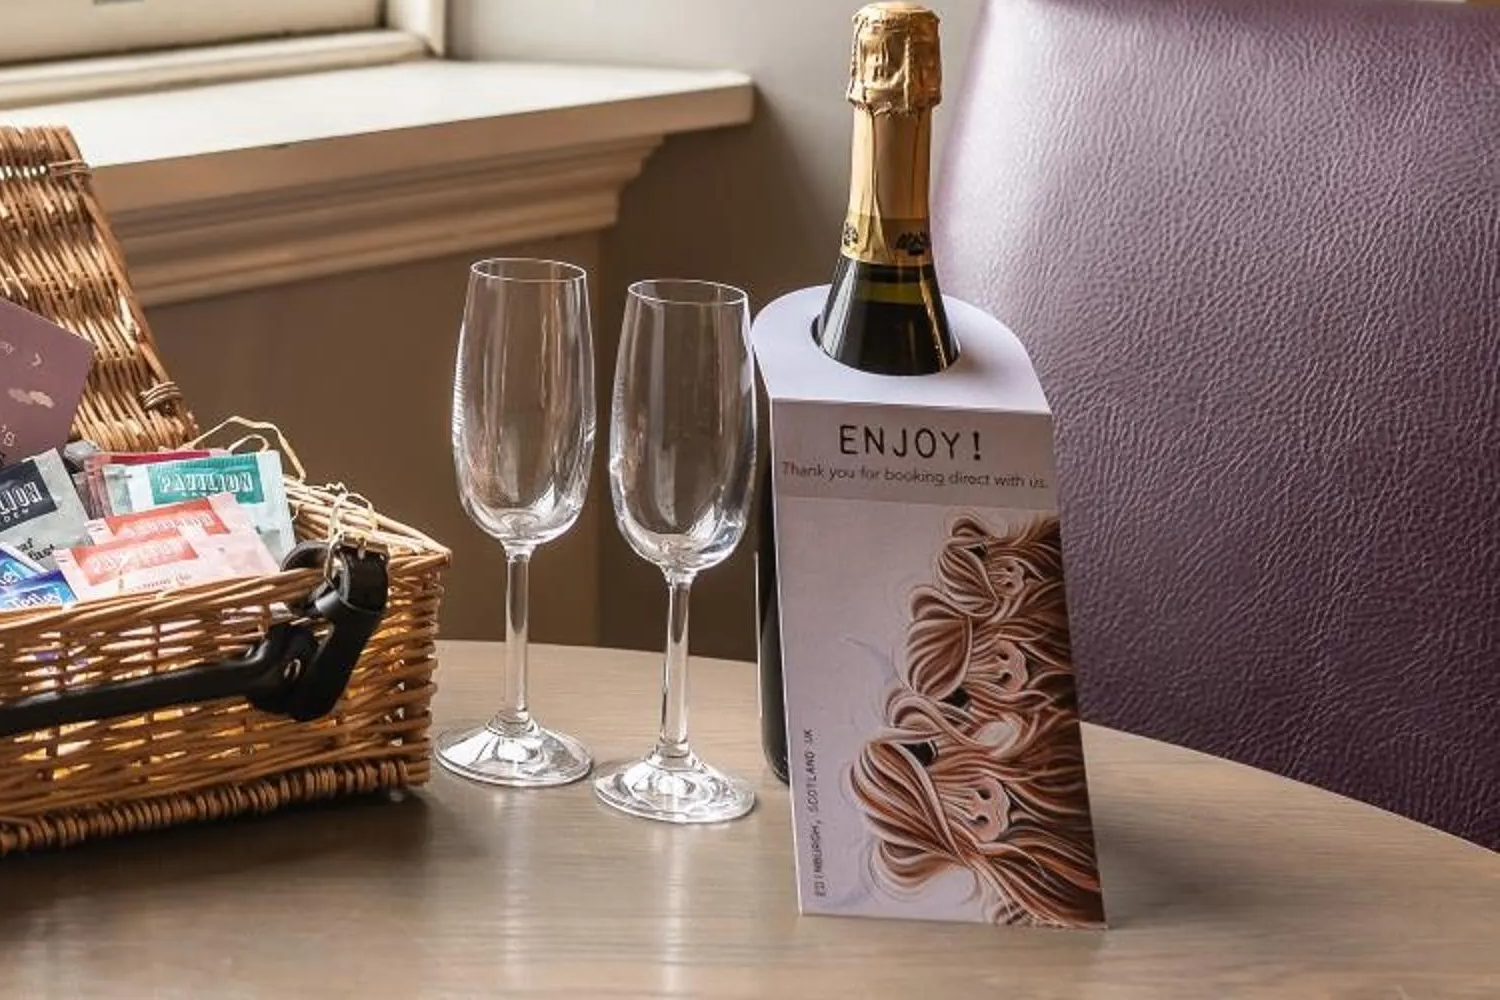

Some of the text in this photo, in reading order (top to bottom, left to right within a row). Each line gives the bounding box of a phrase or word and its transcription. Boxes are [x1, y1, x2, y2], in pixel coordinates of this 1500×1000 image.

[838, 424, 982, 461] ENJOY!
[781, 460, 1049, 489] Thank you for booking direct with us.
[803, 728, 826, 897] EDINBURGH, SCOTLAND UK
